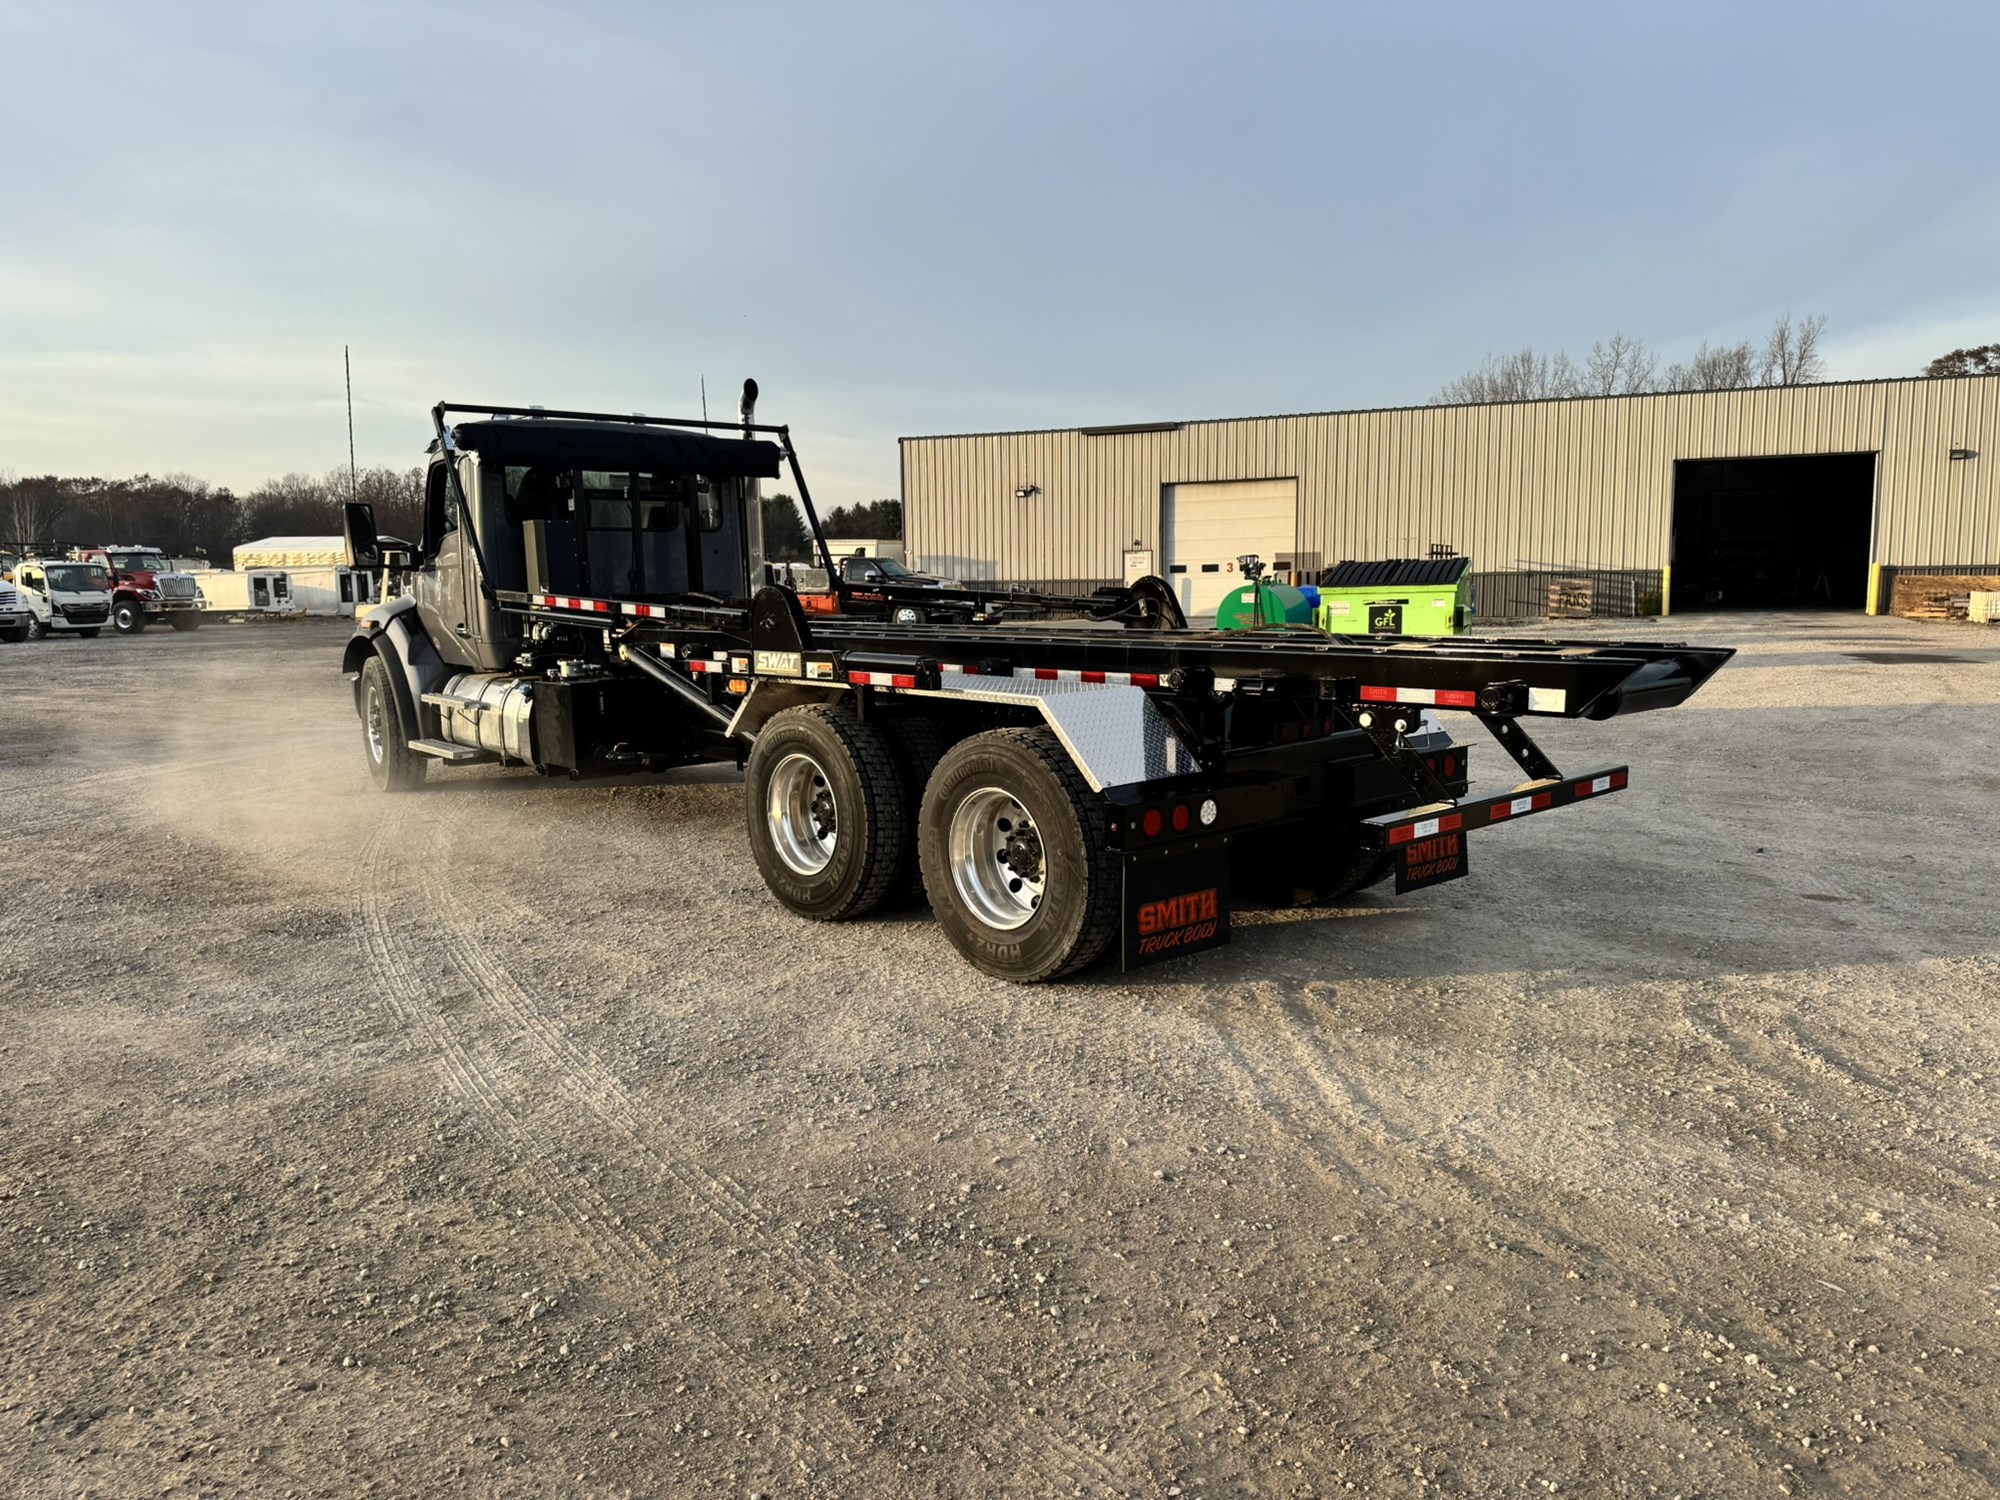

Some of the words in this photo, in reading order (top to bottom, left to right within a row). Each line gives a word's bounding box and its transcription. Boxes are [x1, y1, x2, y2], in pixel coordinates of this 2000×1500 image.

[1226, 562, 1234, 573] 3
[1374, 614, 1396, 627] GFL
[756, 652, 798, 669] SWAT
[1406, 835, 1459, 865] SMITH
[1406, 861, 1435, 881] TRUCK
[1435, 855, 1459, 874] BODY
[1137, 887, 1218, 935] SMITH
[1139, 929, 1184, 954] TRUCK
[1183, 921, 1218, 944] BODY
